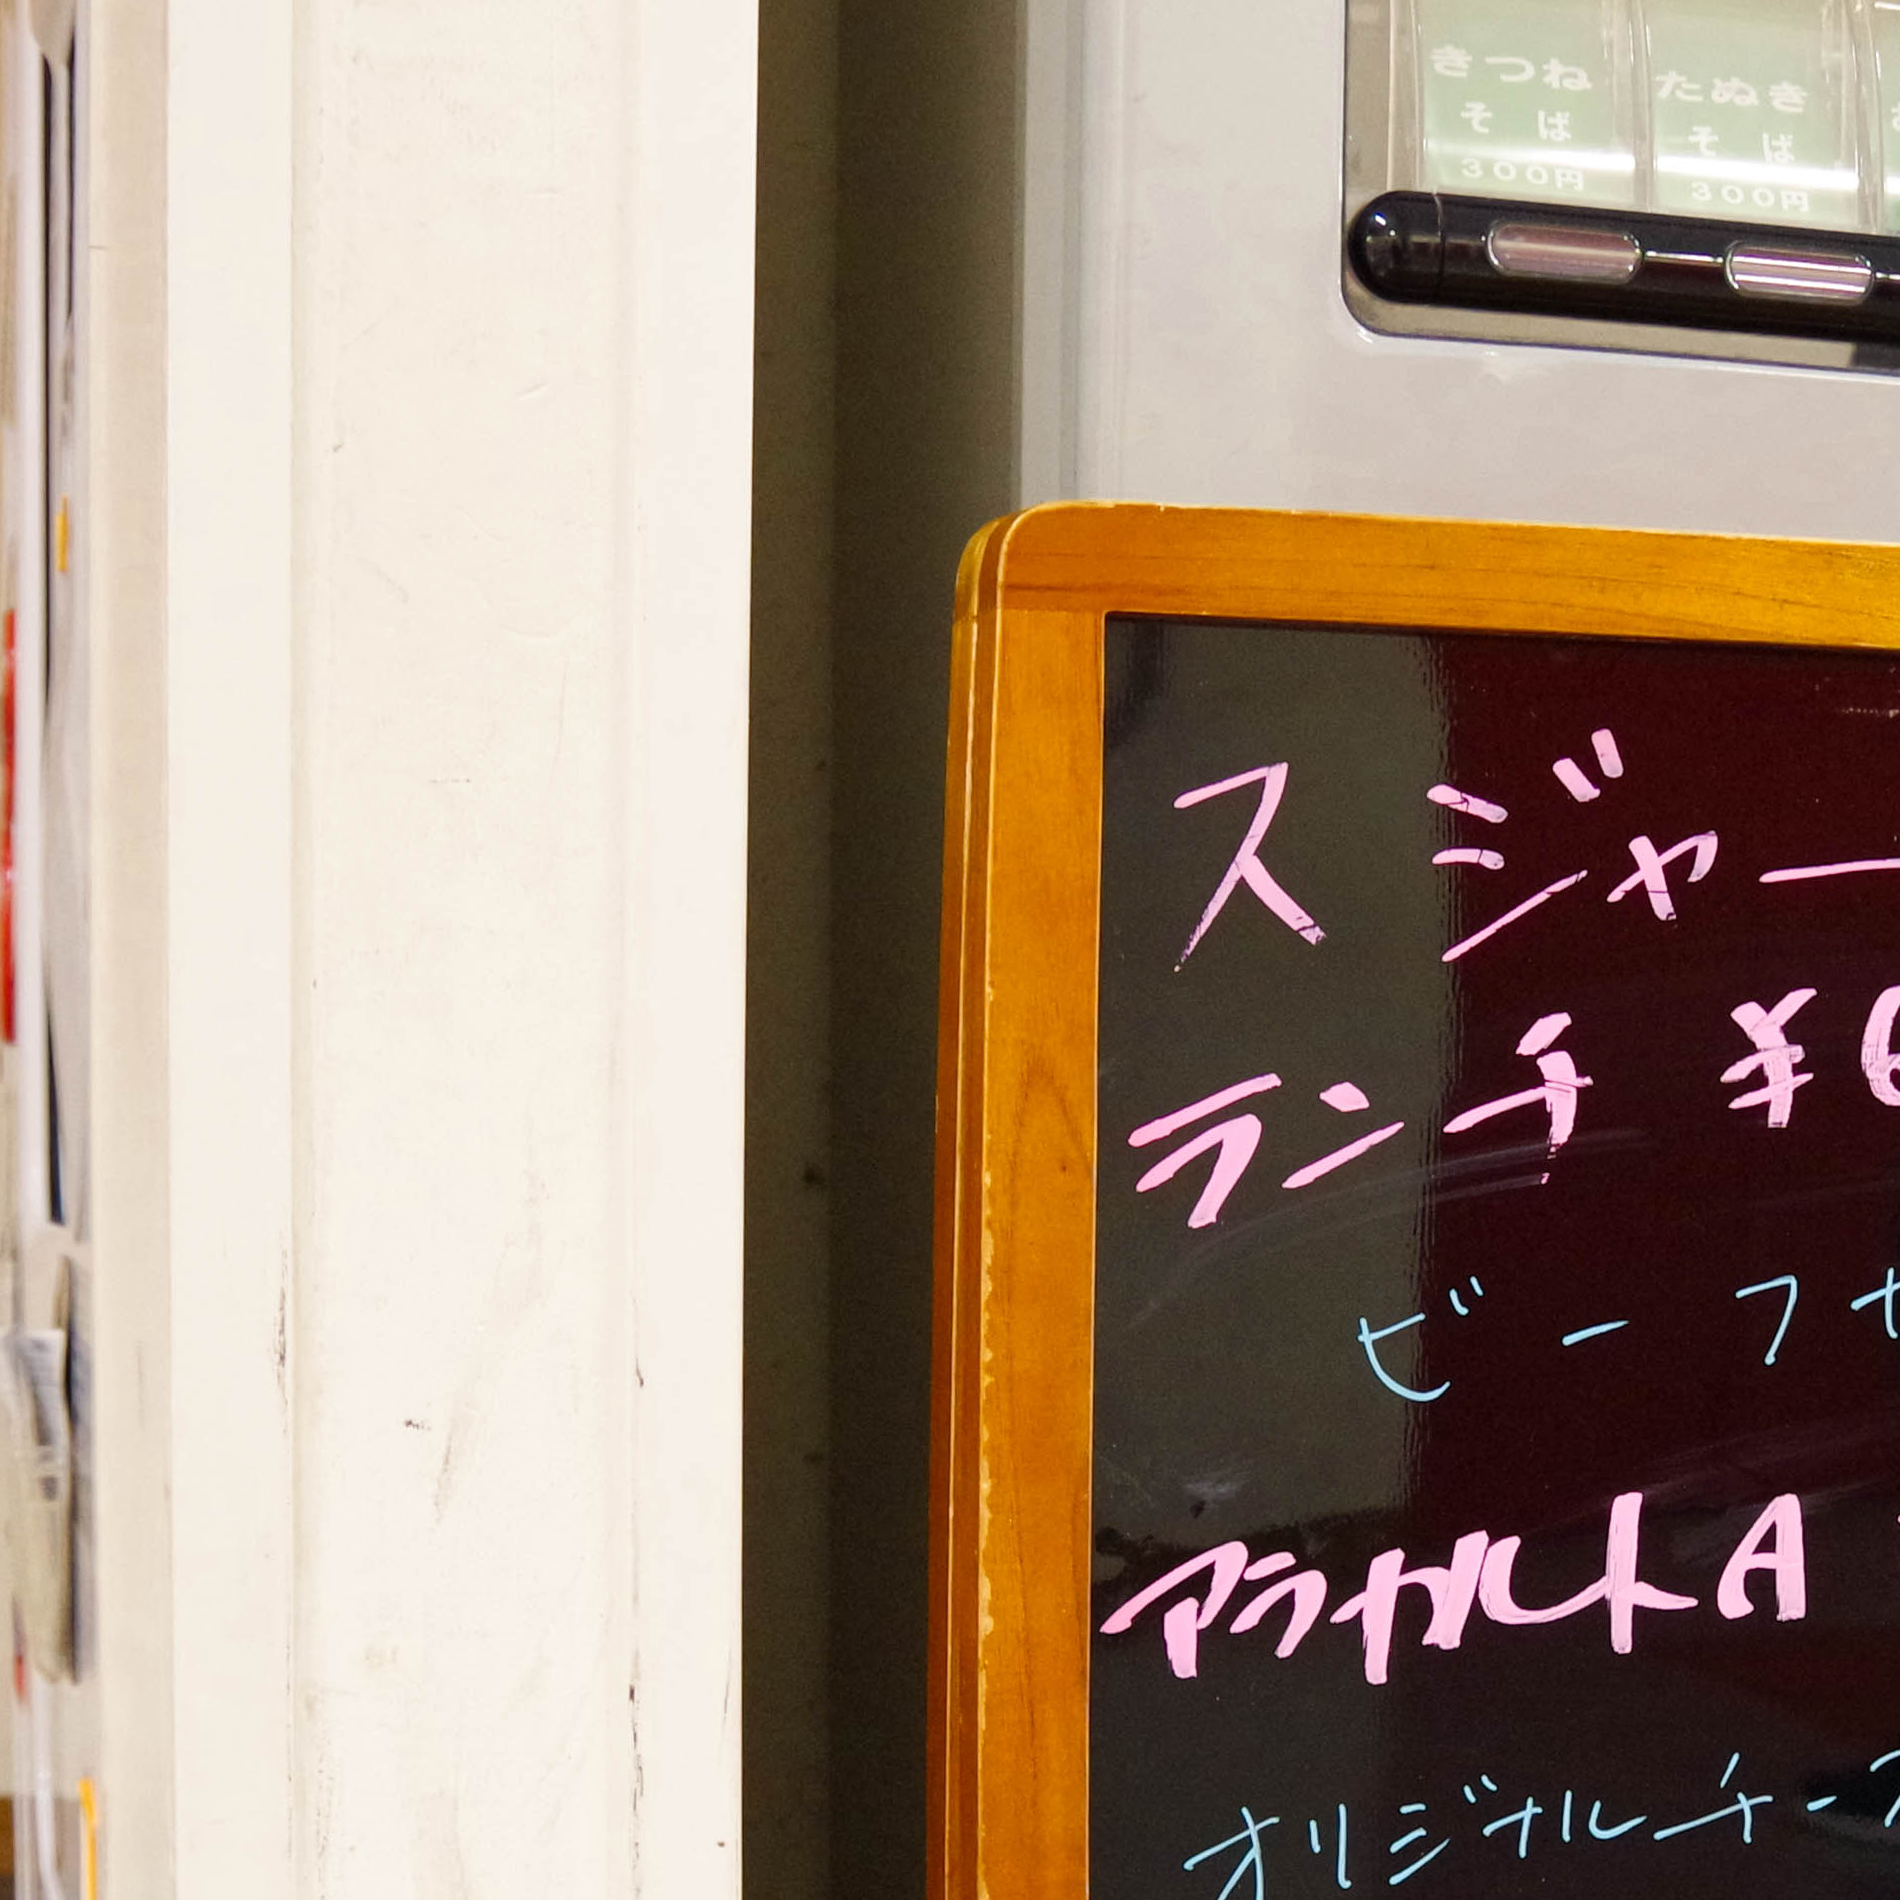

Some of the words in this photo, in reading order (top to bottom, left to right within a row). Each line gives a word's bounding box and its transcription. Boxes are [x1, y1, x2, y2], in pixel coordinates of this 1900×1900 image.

[1430, 45, 1592, 91] きつね
[1655, 70, 1808, 113] たぬき
[1460, 101, 1572, 142] そば
[1688, 126, 1795, 163] そば
[1460, 157, 1584, 191] 300円
[1690, 181, 1811, 212] 300円
[1128, 1012, 1594, 1228] ランチ
